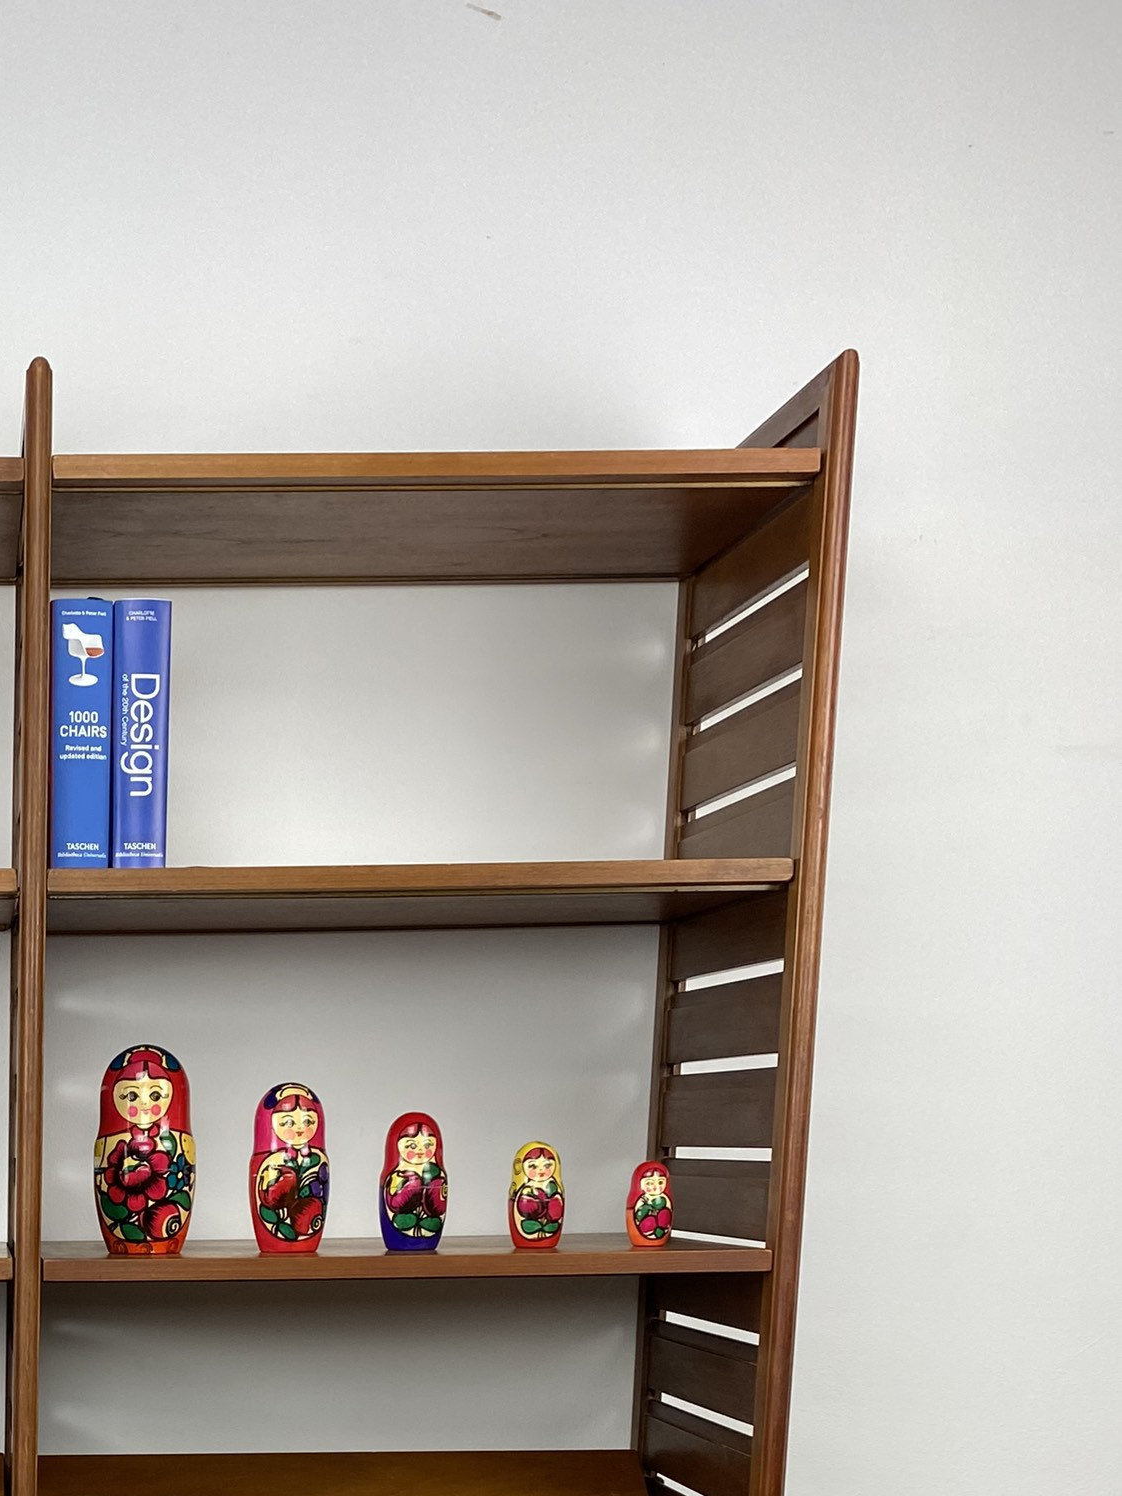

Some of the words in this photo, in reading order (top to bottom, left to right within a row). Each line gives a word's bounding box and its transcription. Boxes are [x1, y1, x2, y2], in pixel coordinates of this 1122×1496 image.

[122, 673, 129, 682] of
[121, 697, 129, 714] 20th
[68, 711, 99, 723] 1000
[59, 725, 107, 738] CHAIRS
[120, 715, 129, 746] Century
[120, 673, 160, 797] Design
[65, 744, 89, 752] Revised
